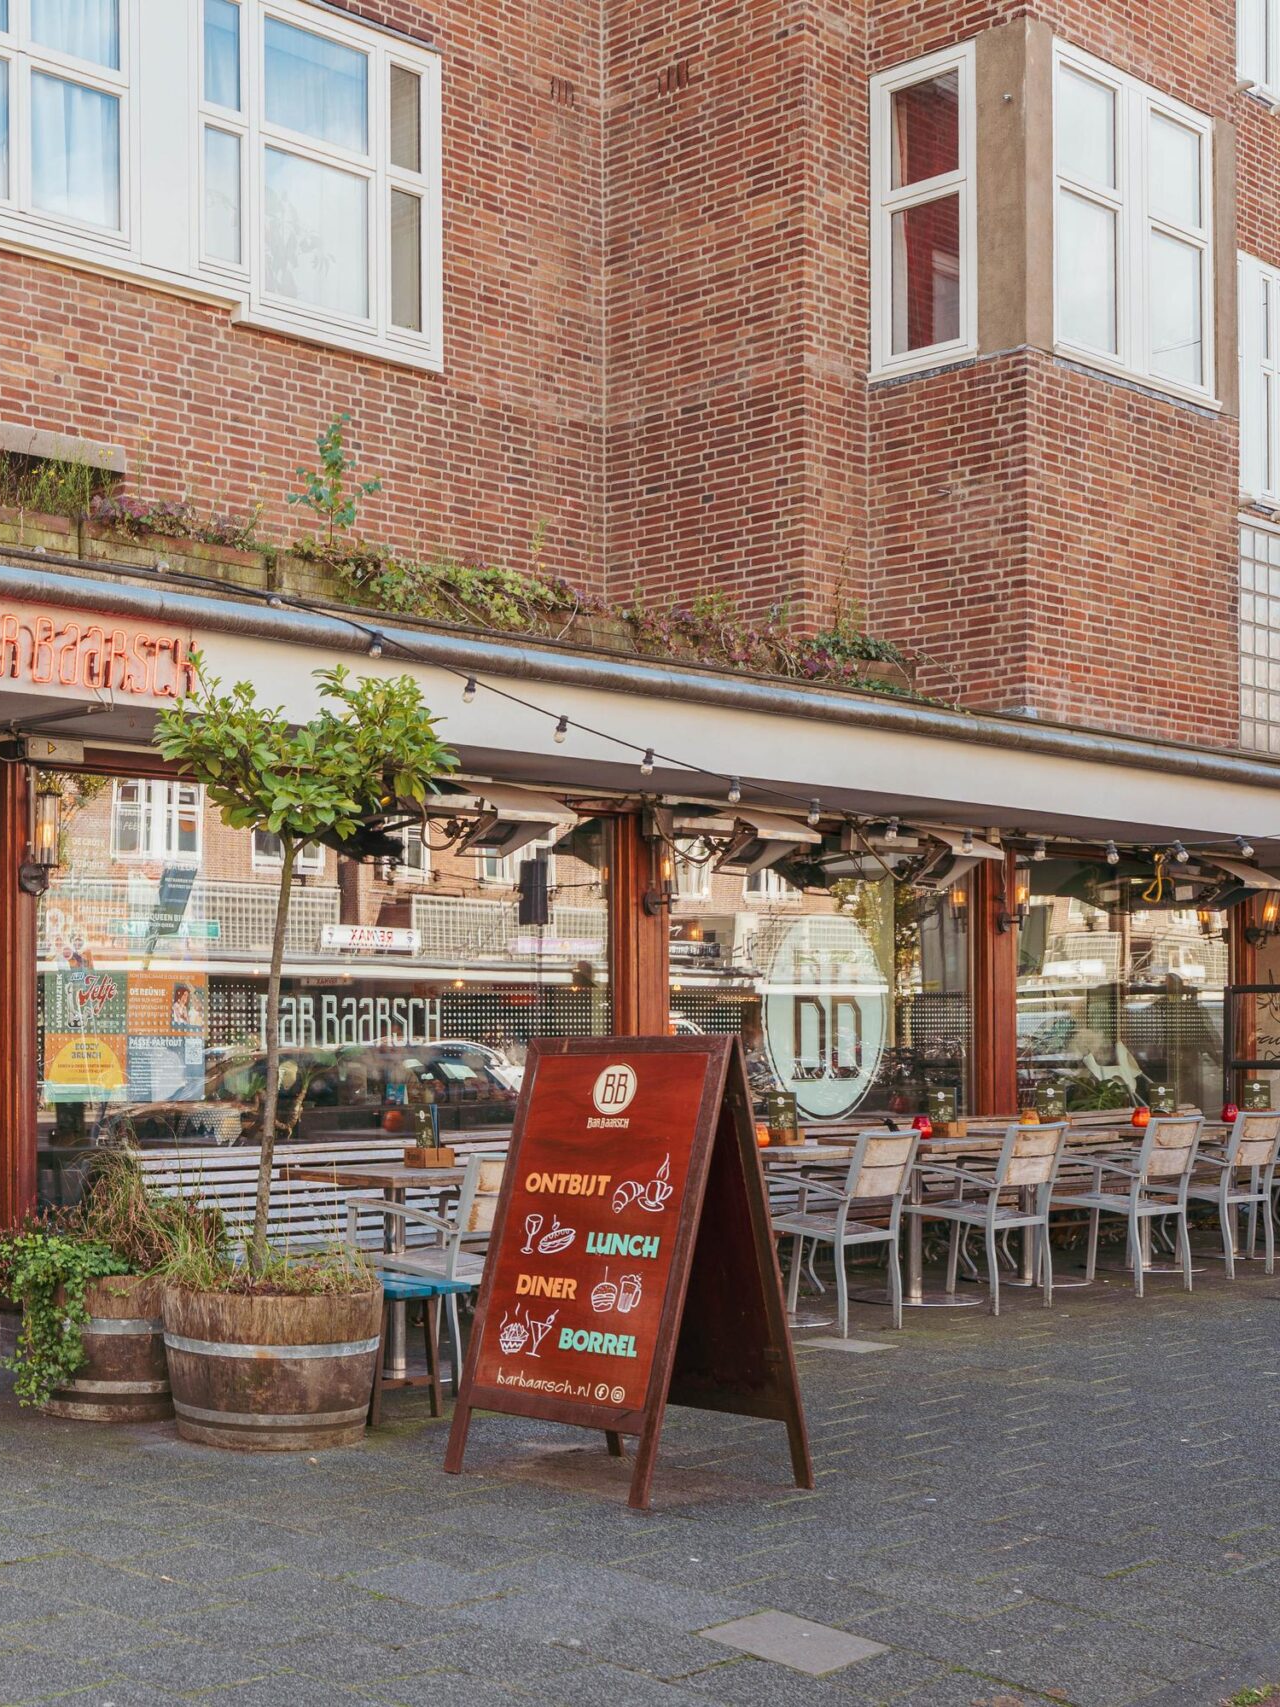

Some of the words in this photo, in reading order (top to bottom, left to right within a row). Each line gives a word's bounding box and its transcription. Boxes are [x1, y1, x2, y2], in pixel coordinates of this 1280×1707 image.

[76, 974, 118, 1016] Jetje
[601, 1073, 629, 1104] BB
[525, 1172, 611, 1197] ONTBIJT
[585, 1232, 660, 1259] LUNCH
[515, 1273, 578, 1300] DINER
[558, 1327, 638, 1358] BORREL
[496, 1366, 592, 1398] barbaarsch.nl
